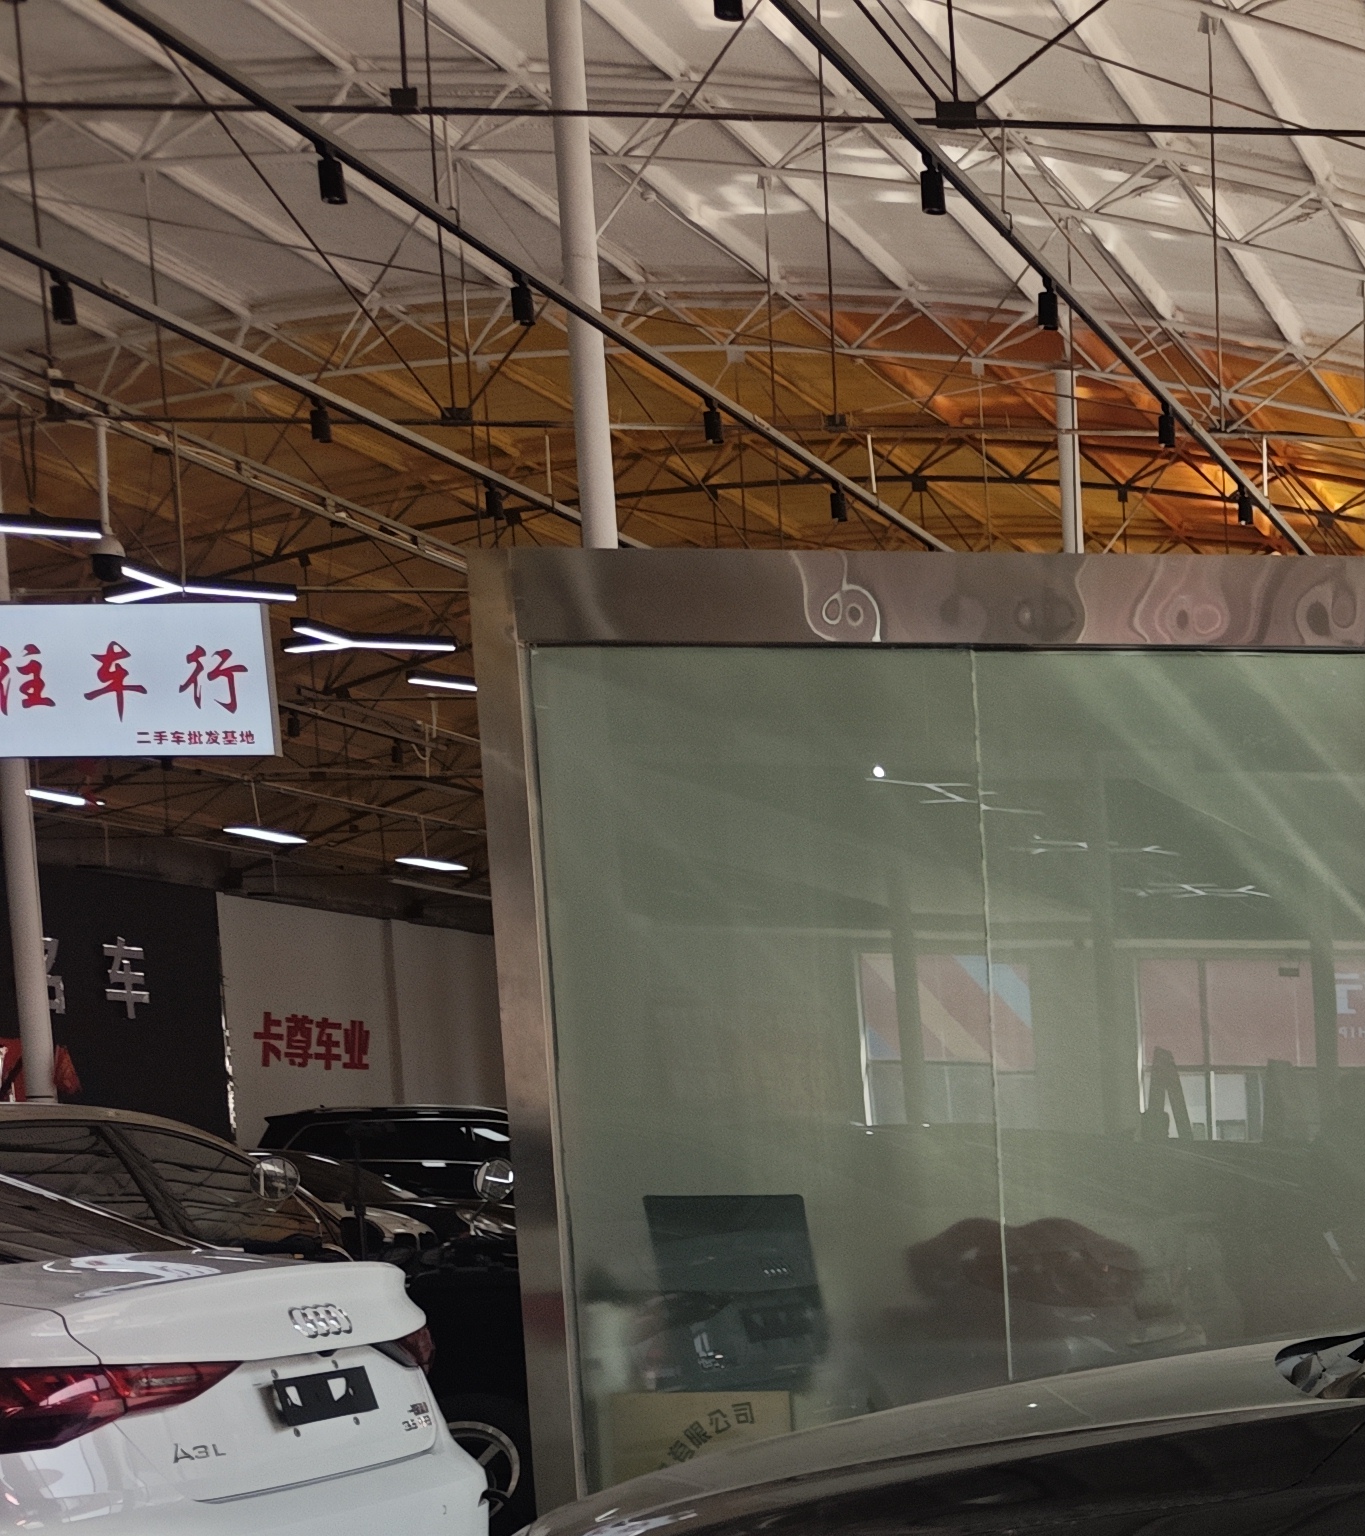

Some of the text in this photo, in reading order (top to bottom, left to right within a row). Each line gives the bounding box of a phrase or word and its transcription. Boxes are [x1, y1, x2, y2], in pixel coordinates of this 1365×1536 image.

[136, 730, 256, 746] 二手车批发基地
[253, 1011, 370, 1070] 卡尊车业
[660, 1402, 755, 1468] 有限公司
